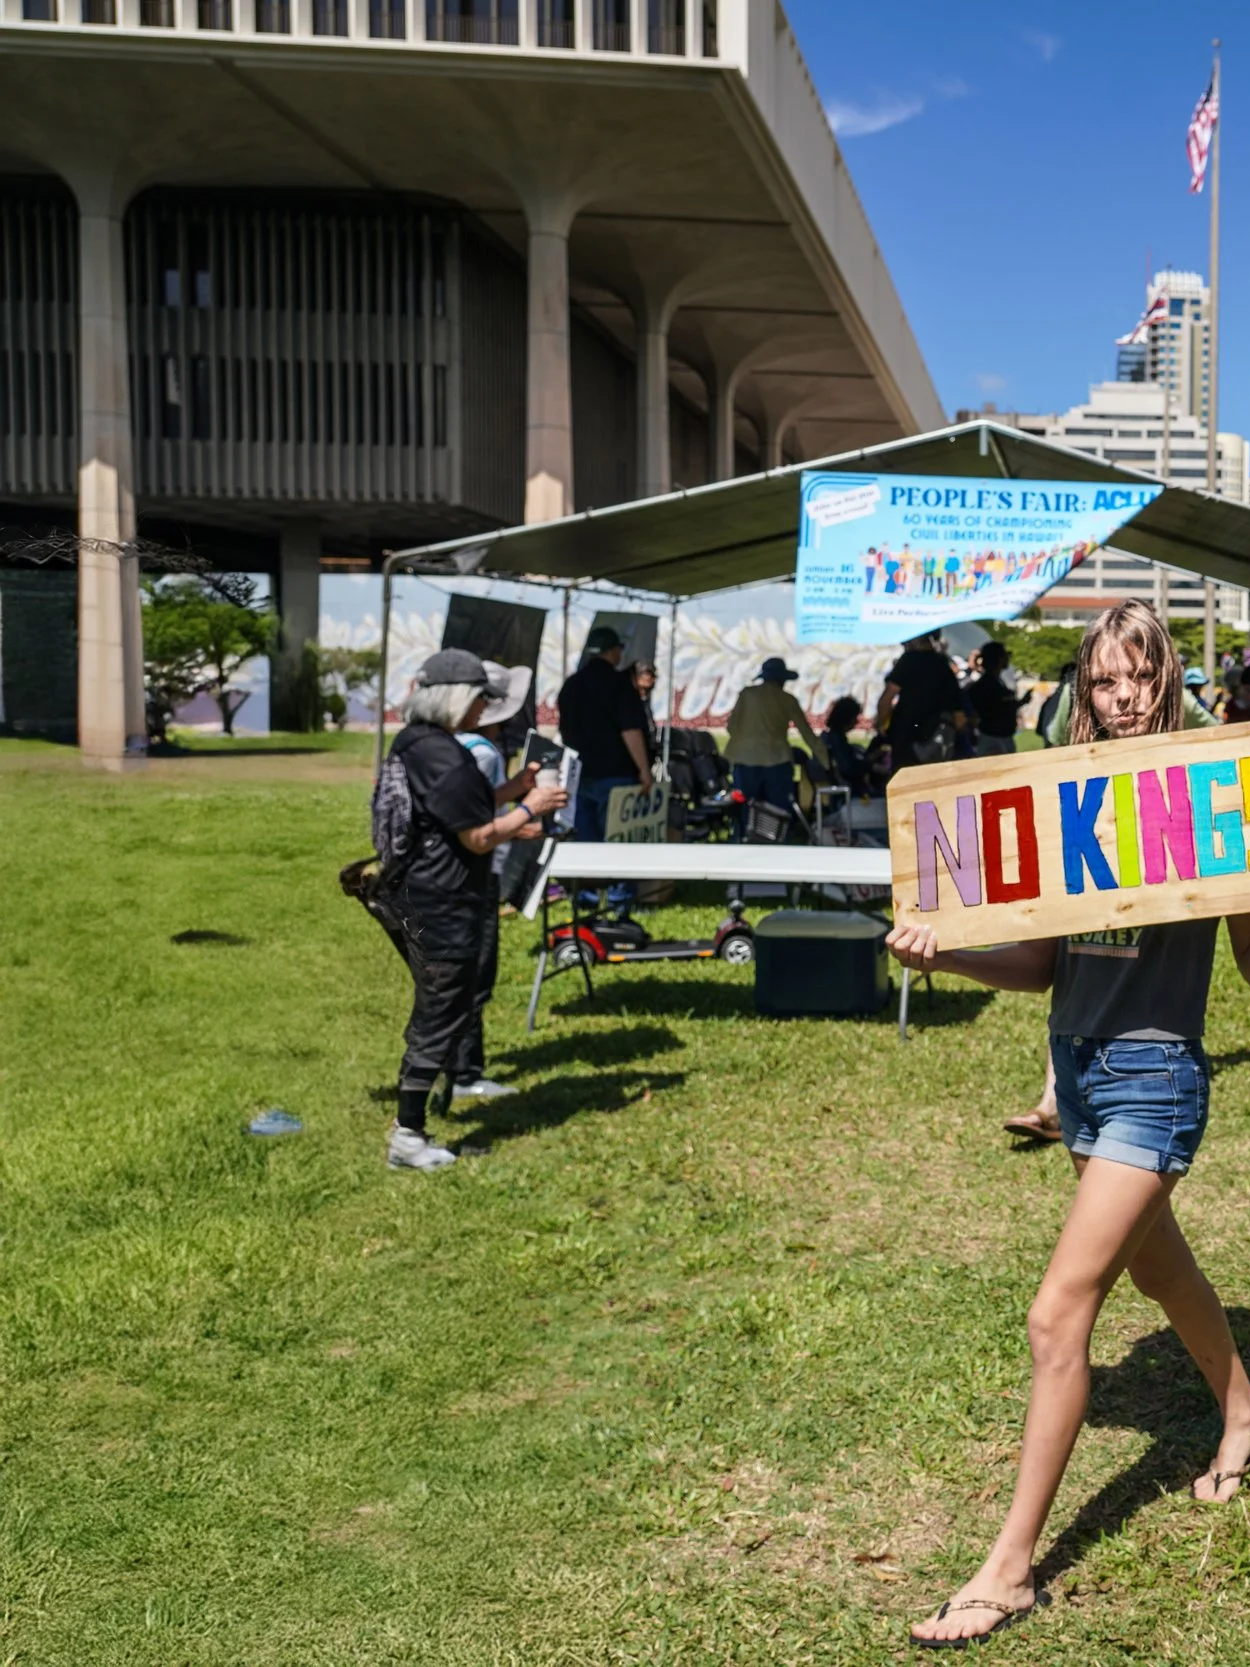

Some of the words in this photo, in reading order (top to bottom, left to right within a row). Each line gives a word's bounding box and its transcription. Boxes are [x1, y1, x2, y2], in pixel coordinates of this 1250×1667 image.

[890, 486, 1013, 510] PEOPLE'S
[1020, 490, 1087, 512] FAIR:
[926, 514, 960, 526] YEARS
[964, 515, 980, 527] OF
[619, 787, 664, 824] GOOD
[914, 785, 1040, 912] NO
